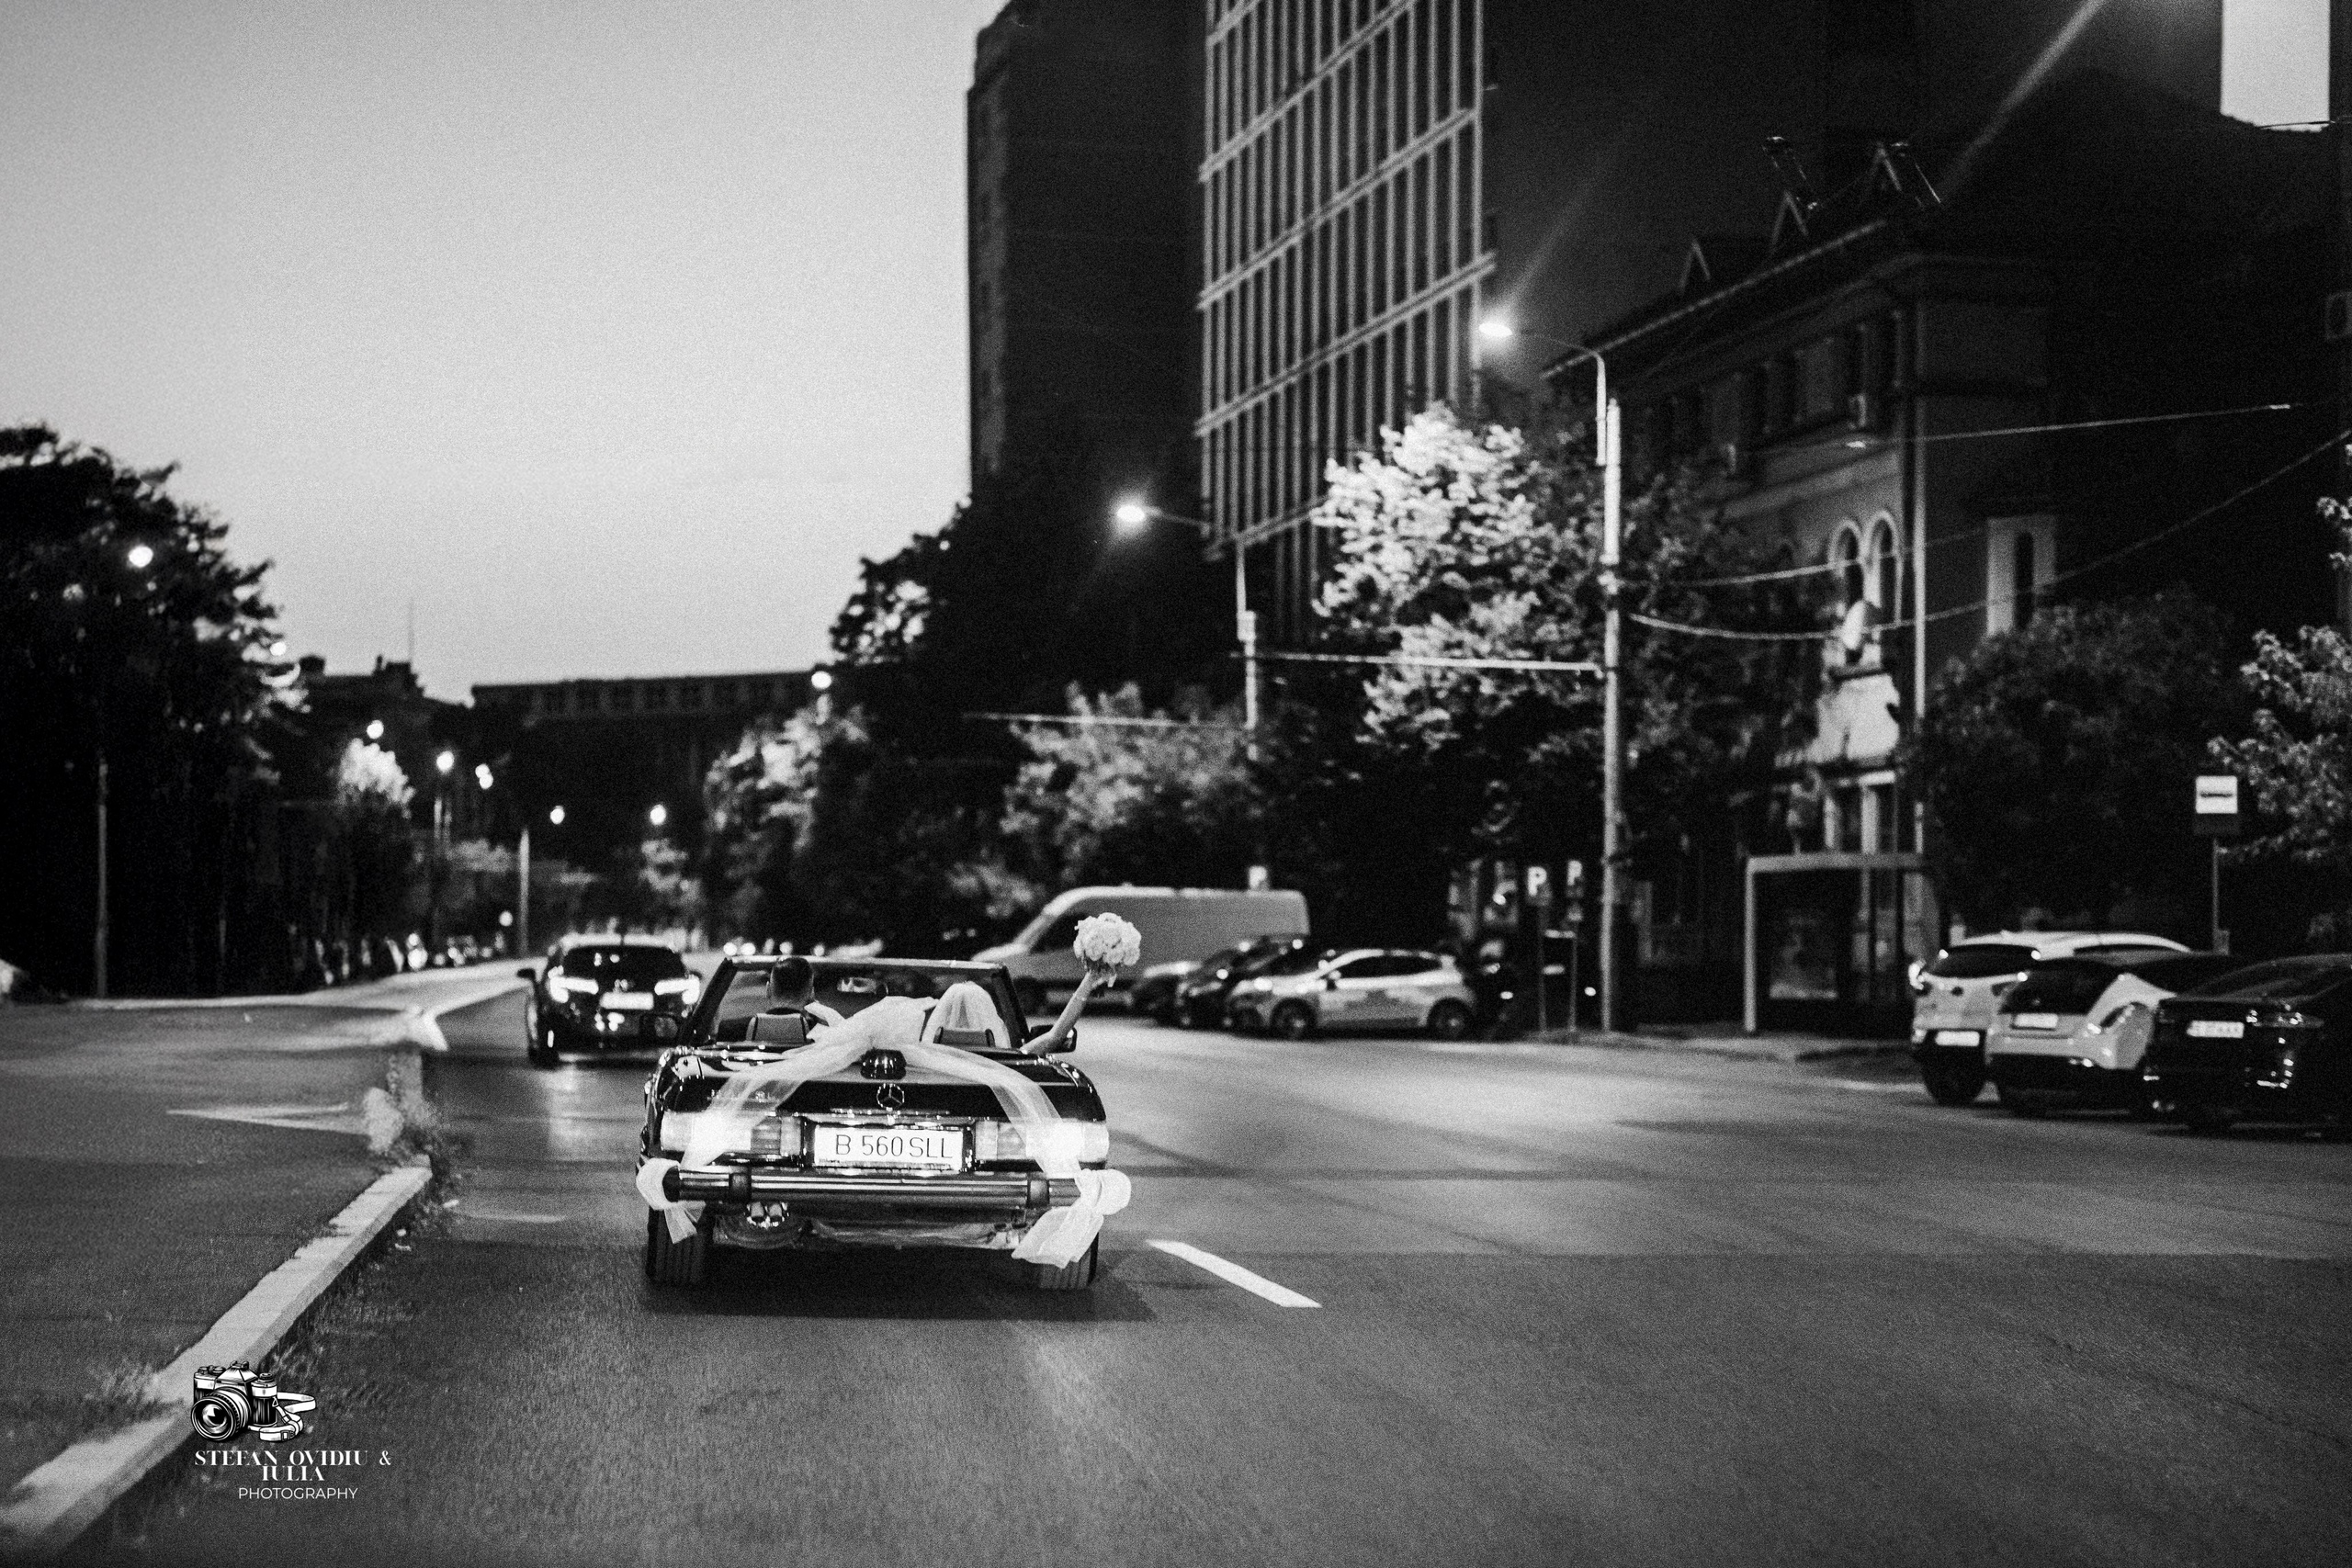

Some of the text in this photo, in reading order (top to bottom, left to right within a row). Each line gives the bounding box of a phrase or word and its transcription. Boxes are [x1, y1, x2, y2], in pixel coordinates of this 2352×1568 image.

[1528, 866, 1547, 897] P
[835, 1134, 953, 1158] B 560 SLL
